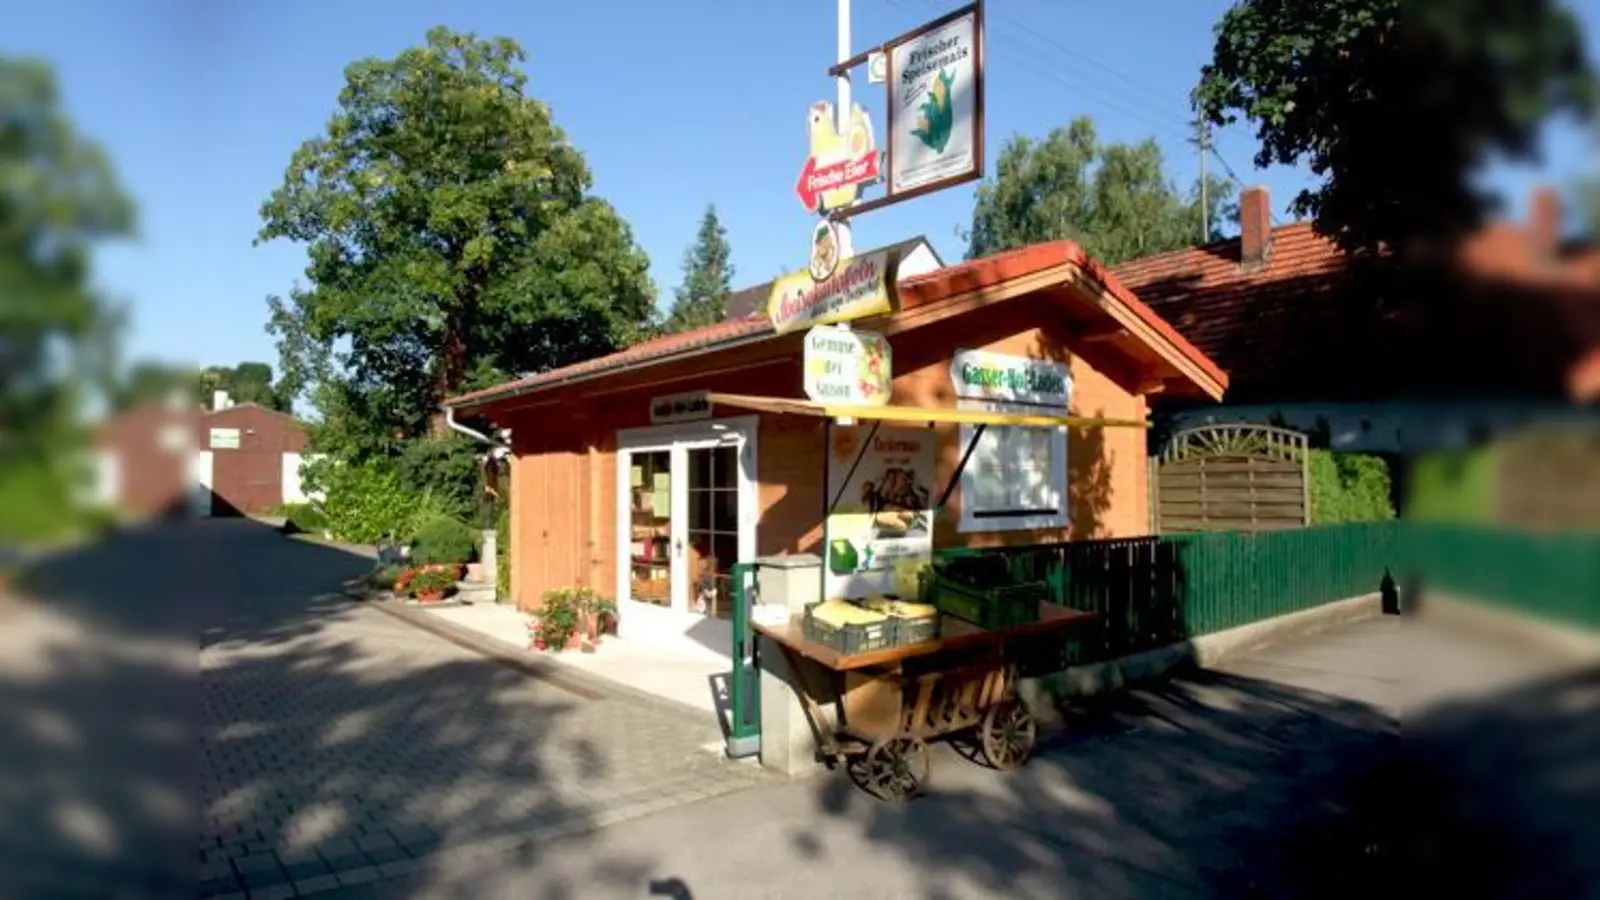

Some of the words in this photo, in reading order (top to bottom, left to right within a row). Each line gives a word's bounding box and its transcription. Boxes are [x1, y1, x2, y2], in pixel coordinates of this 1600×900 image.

[902, 48, 968, 84] Speisemais
[909, 35, 960, 66] Frischer
[807, 170, 844, 192] Frische
[844, 161, 869, 180] Eier
